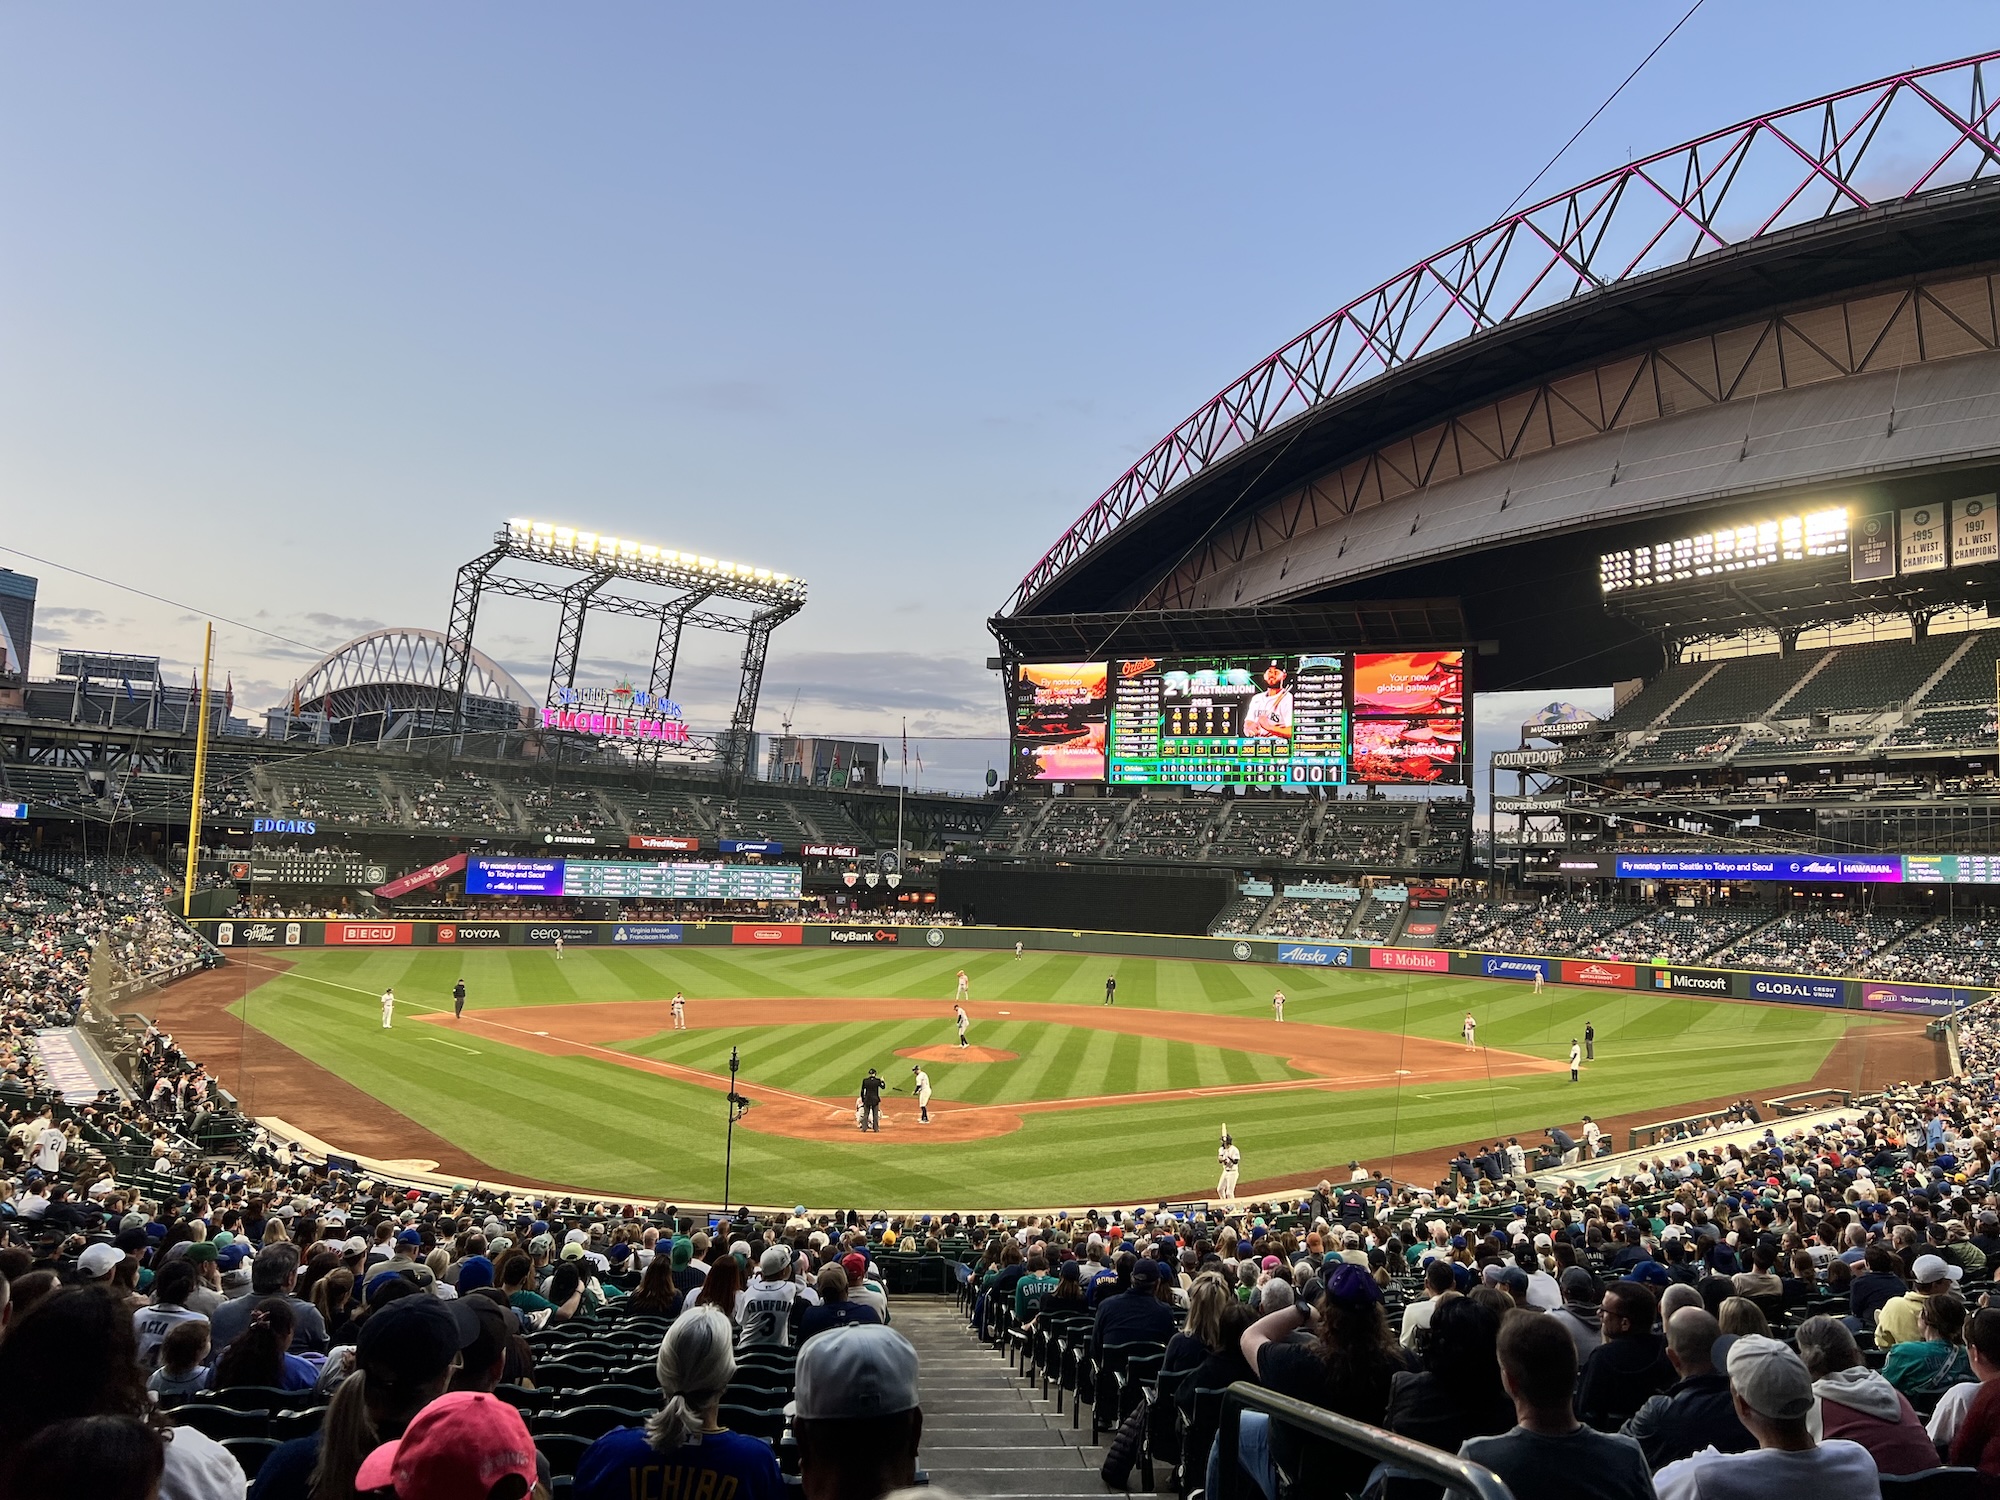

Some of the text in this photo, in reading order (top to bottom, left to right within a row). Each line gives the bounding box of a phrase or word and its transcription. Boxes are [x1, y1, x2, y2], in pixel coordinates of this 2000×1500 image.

[1965, 520, 1984, 532] 1997
[1912, 529, 1932, 541] 1995
[1959, 533, 1992, 546] A.L. WEST
[1907, 542, 1939, 555] A.L. WEST
[1955, 545, 1996, 560] CHAMPIONS
[1904, 553, 1943, 568] CHAMPIONS
[1390, 674, 1408, 682] Your
[1164, 678, 1190, 696] 21
[1191, 685, 1255, 694] MASTROBUONI
[1377, 684, 1441, 694] global gateway
[558, 687, 682, 718] SEATTLE MARINERS
[1034, 696, 1055, 705] Tokyo
[540, 707, 690, 742] T-MOBILE PARK
[1530, 722, 1589, 733] MUCKLESHOOT
[1293, 766, 1337, 781] 0 0 1
[1496, 800, 1565, 810] COOPERSTOWN
[254, 819, 316, 834] EDGARS
[1522, 832, 1565, 843] 54 DAYS
[1623, 861, 1632, 870] Fly
[1634, 863, 1660, 872] nonstop
[1662, 862, 1678, 870] from
[1679, 862, 1704, 871] Seattle
[1714, 863, 1735, 872] Tokyo
[1737, 863, 1750, 871] and
[1752, 863, 1773, 872] Seoul
[410, 872, 431, 885] Mobile
[348, 928, 392, 939] BECU
[459, 928, 501, 939] TOYOTA
[530, 928, 560, 939] eero
[831, 931, 874, 943] KeyBank
[1282, 947, 1327, 963] Alaska
[1383, 952, 1436, 967] T Mobile
[1500, 962, 1541, 972] BOEING
[1673, 975, 1726, 989] Microsoft
[1756, 981, 1810, 996] GLOBAL
[50, 1139, 61, 1151] 21
[748, 1300, 791, 1312] RAWFOR
[760, 1312, 776, 1336] 3
[630, 1464, 738, 1500] ICHIRO
